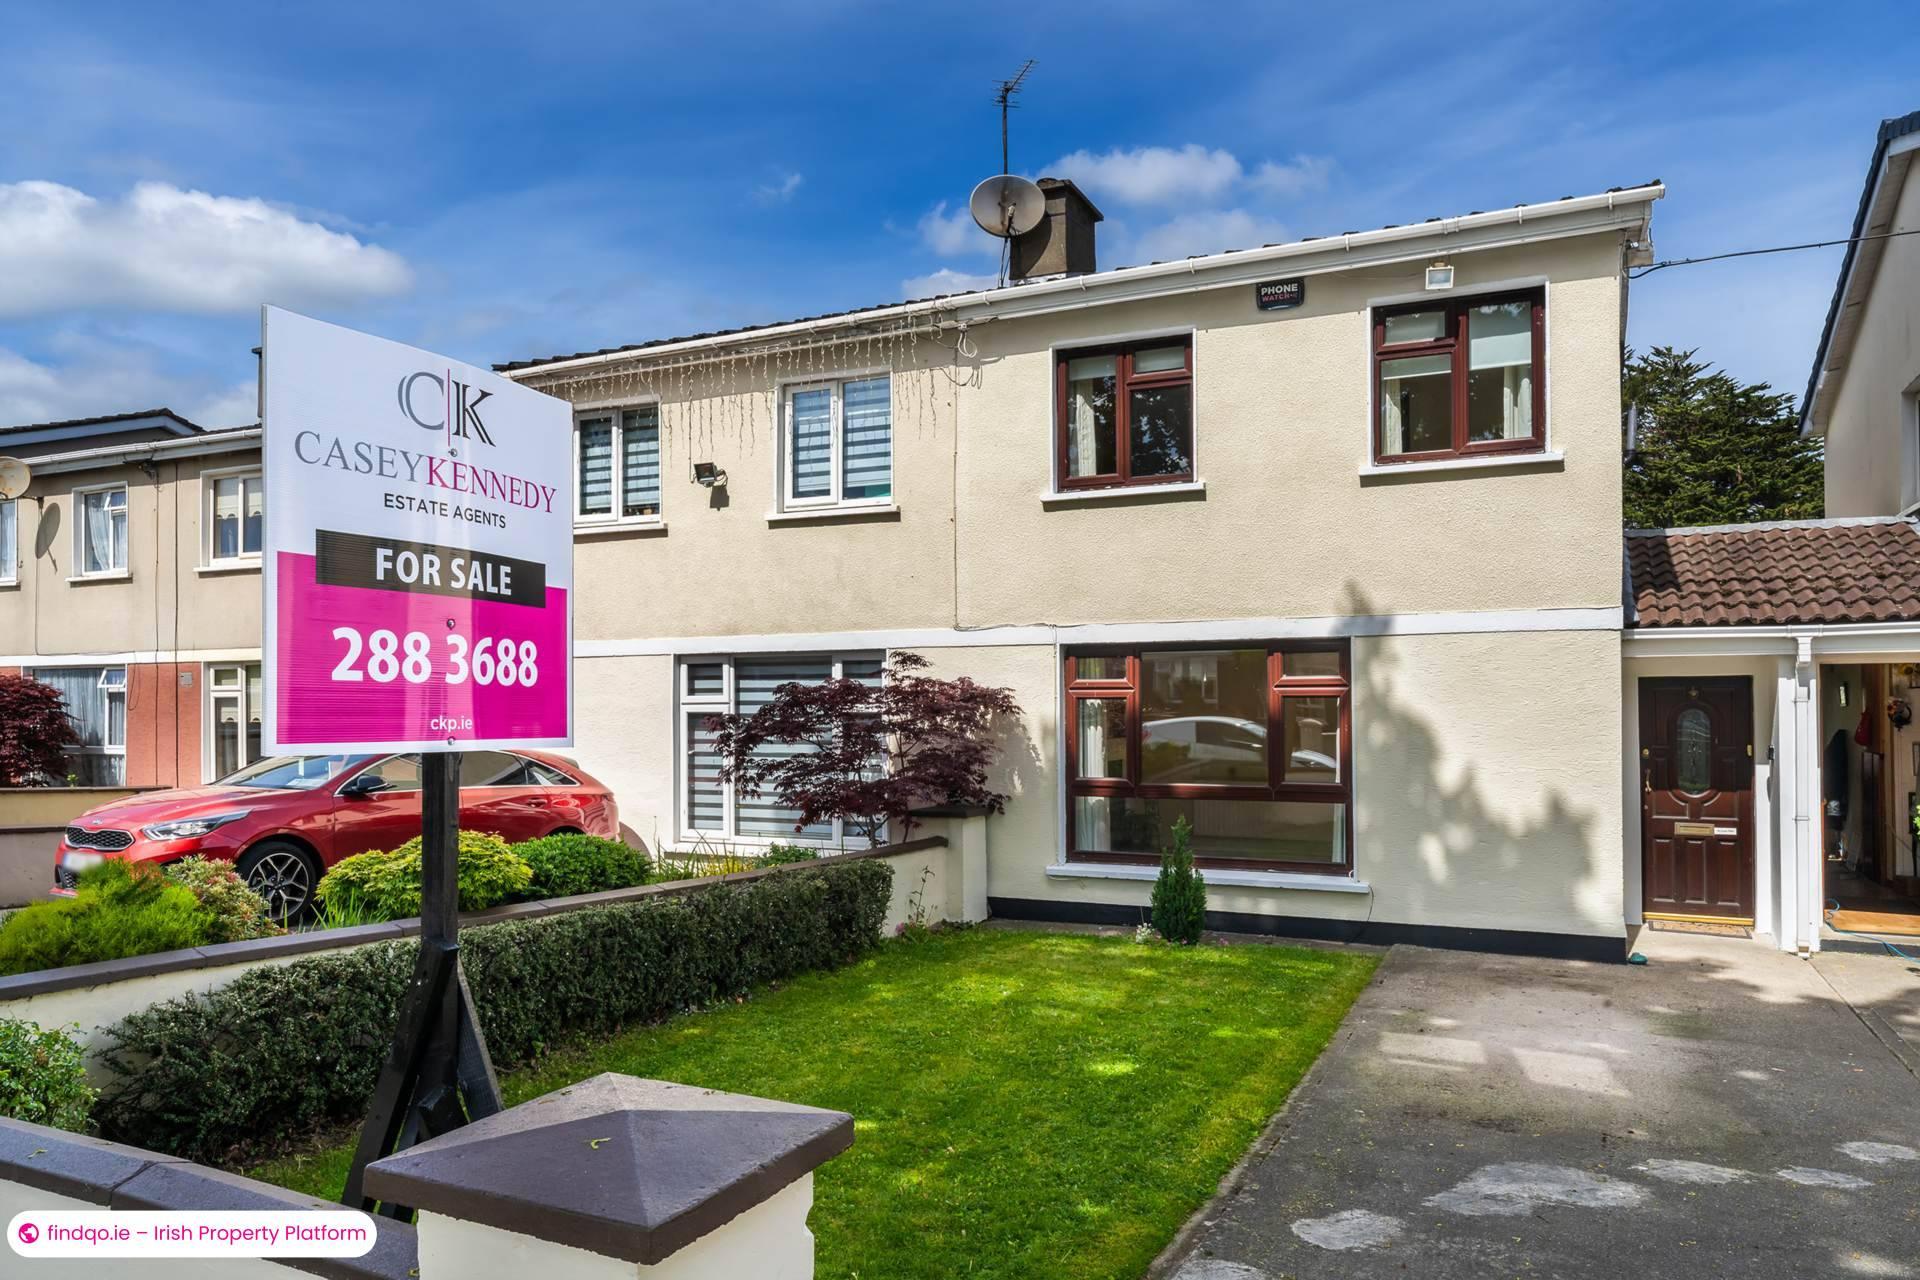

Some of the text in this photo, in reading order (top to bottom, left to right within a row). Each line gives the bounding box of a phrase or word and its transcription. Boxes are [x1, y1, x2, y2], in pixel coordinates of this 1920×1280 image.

[1261, 283, 1298, 296] PHONE
[1263, 292, 1290, 302] WATCH
[384, 493, 506, 529] ESTATE AGENTS
[376, 548, 512, 596] FOR SALE
[331, 627, 538, 687] 288 3688
[430, 716, 473, 731] ckp.ie
